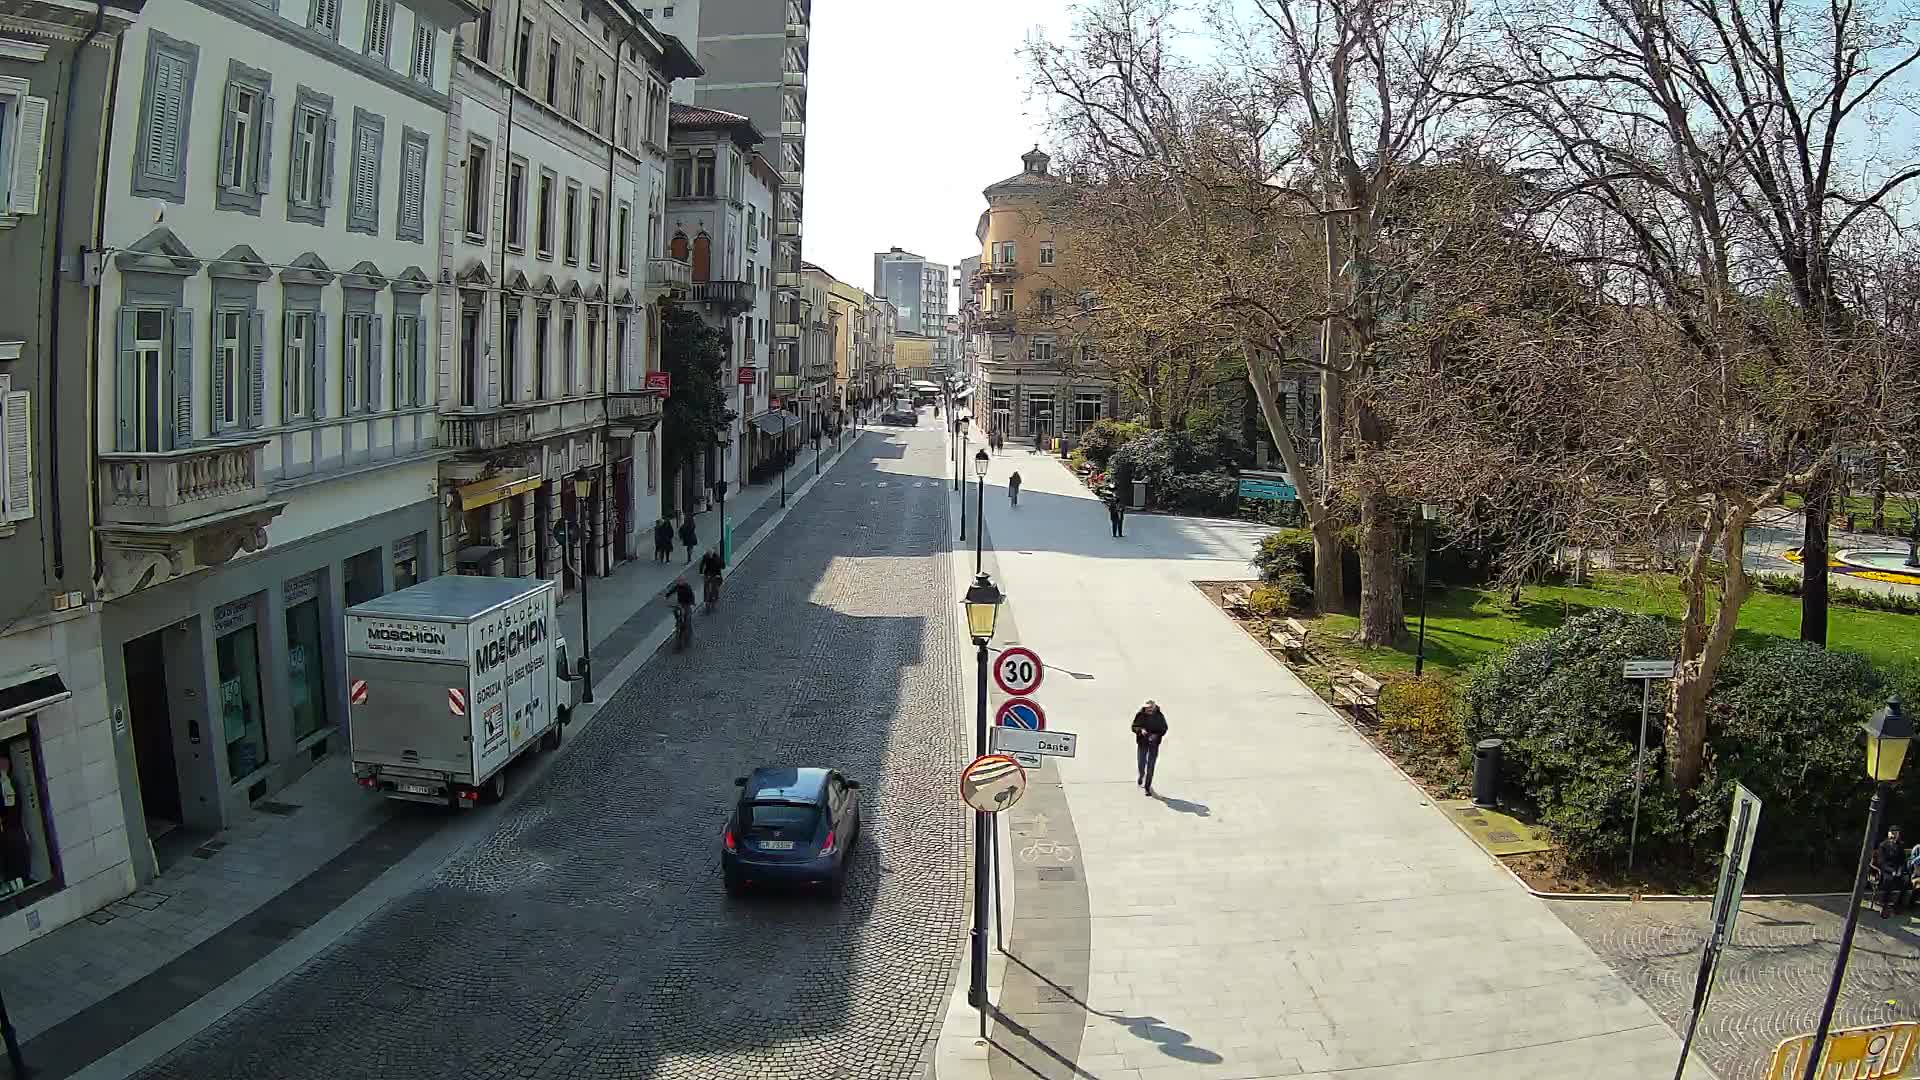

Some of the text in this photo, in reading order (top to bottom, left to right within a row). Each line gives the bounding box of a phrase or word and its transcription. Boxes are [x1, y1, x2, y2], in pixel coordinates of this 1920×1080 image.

[480, 600, 544, 640] TRASLOCHI
[367, 628, 446, 645] MOSCHION
[475, 615, 547, 677] MOSCHION
[1004, 660, 1033, 684] 30
[1038, 740, 1070, 752] Dante
